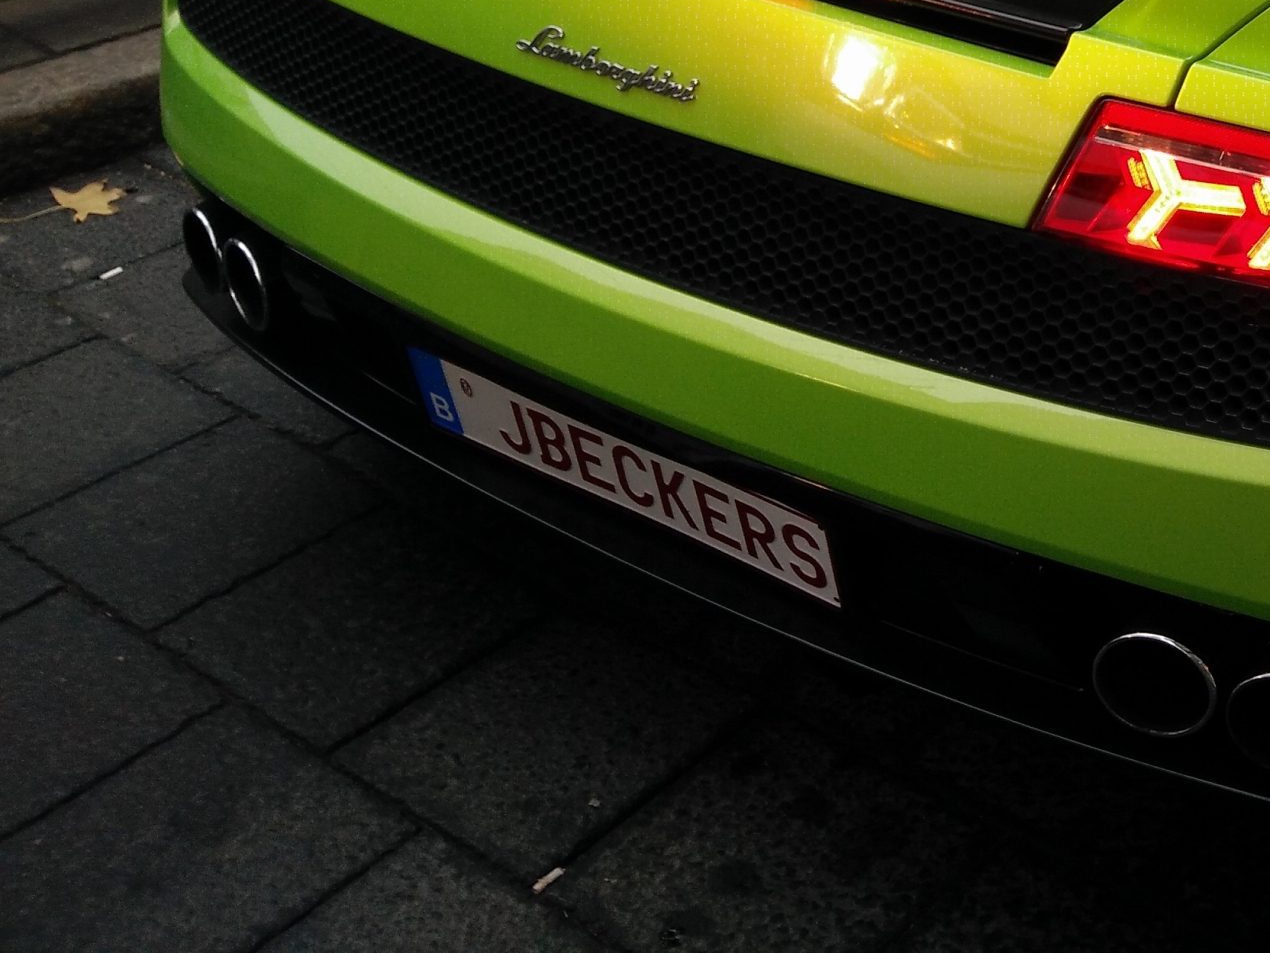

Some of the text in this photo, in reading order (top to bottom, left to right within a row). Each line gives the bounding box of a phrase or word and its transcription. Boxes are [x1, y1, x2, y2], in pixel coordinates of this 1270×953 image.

[516, 24, 701, 102] Lamborghini
[429, 393, 454, 423] B
[499, 400, 828, 589] JBECKERS
